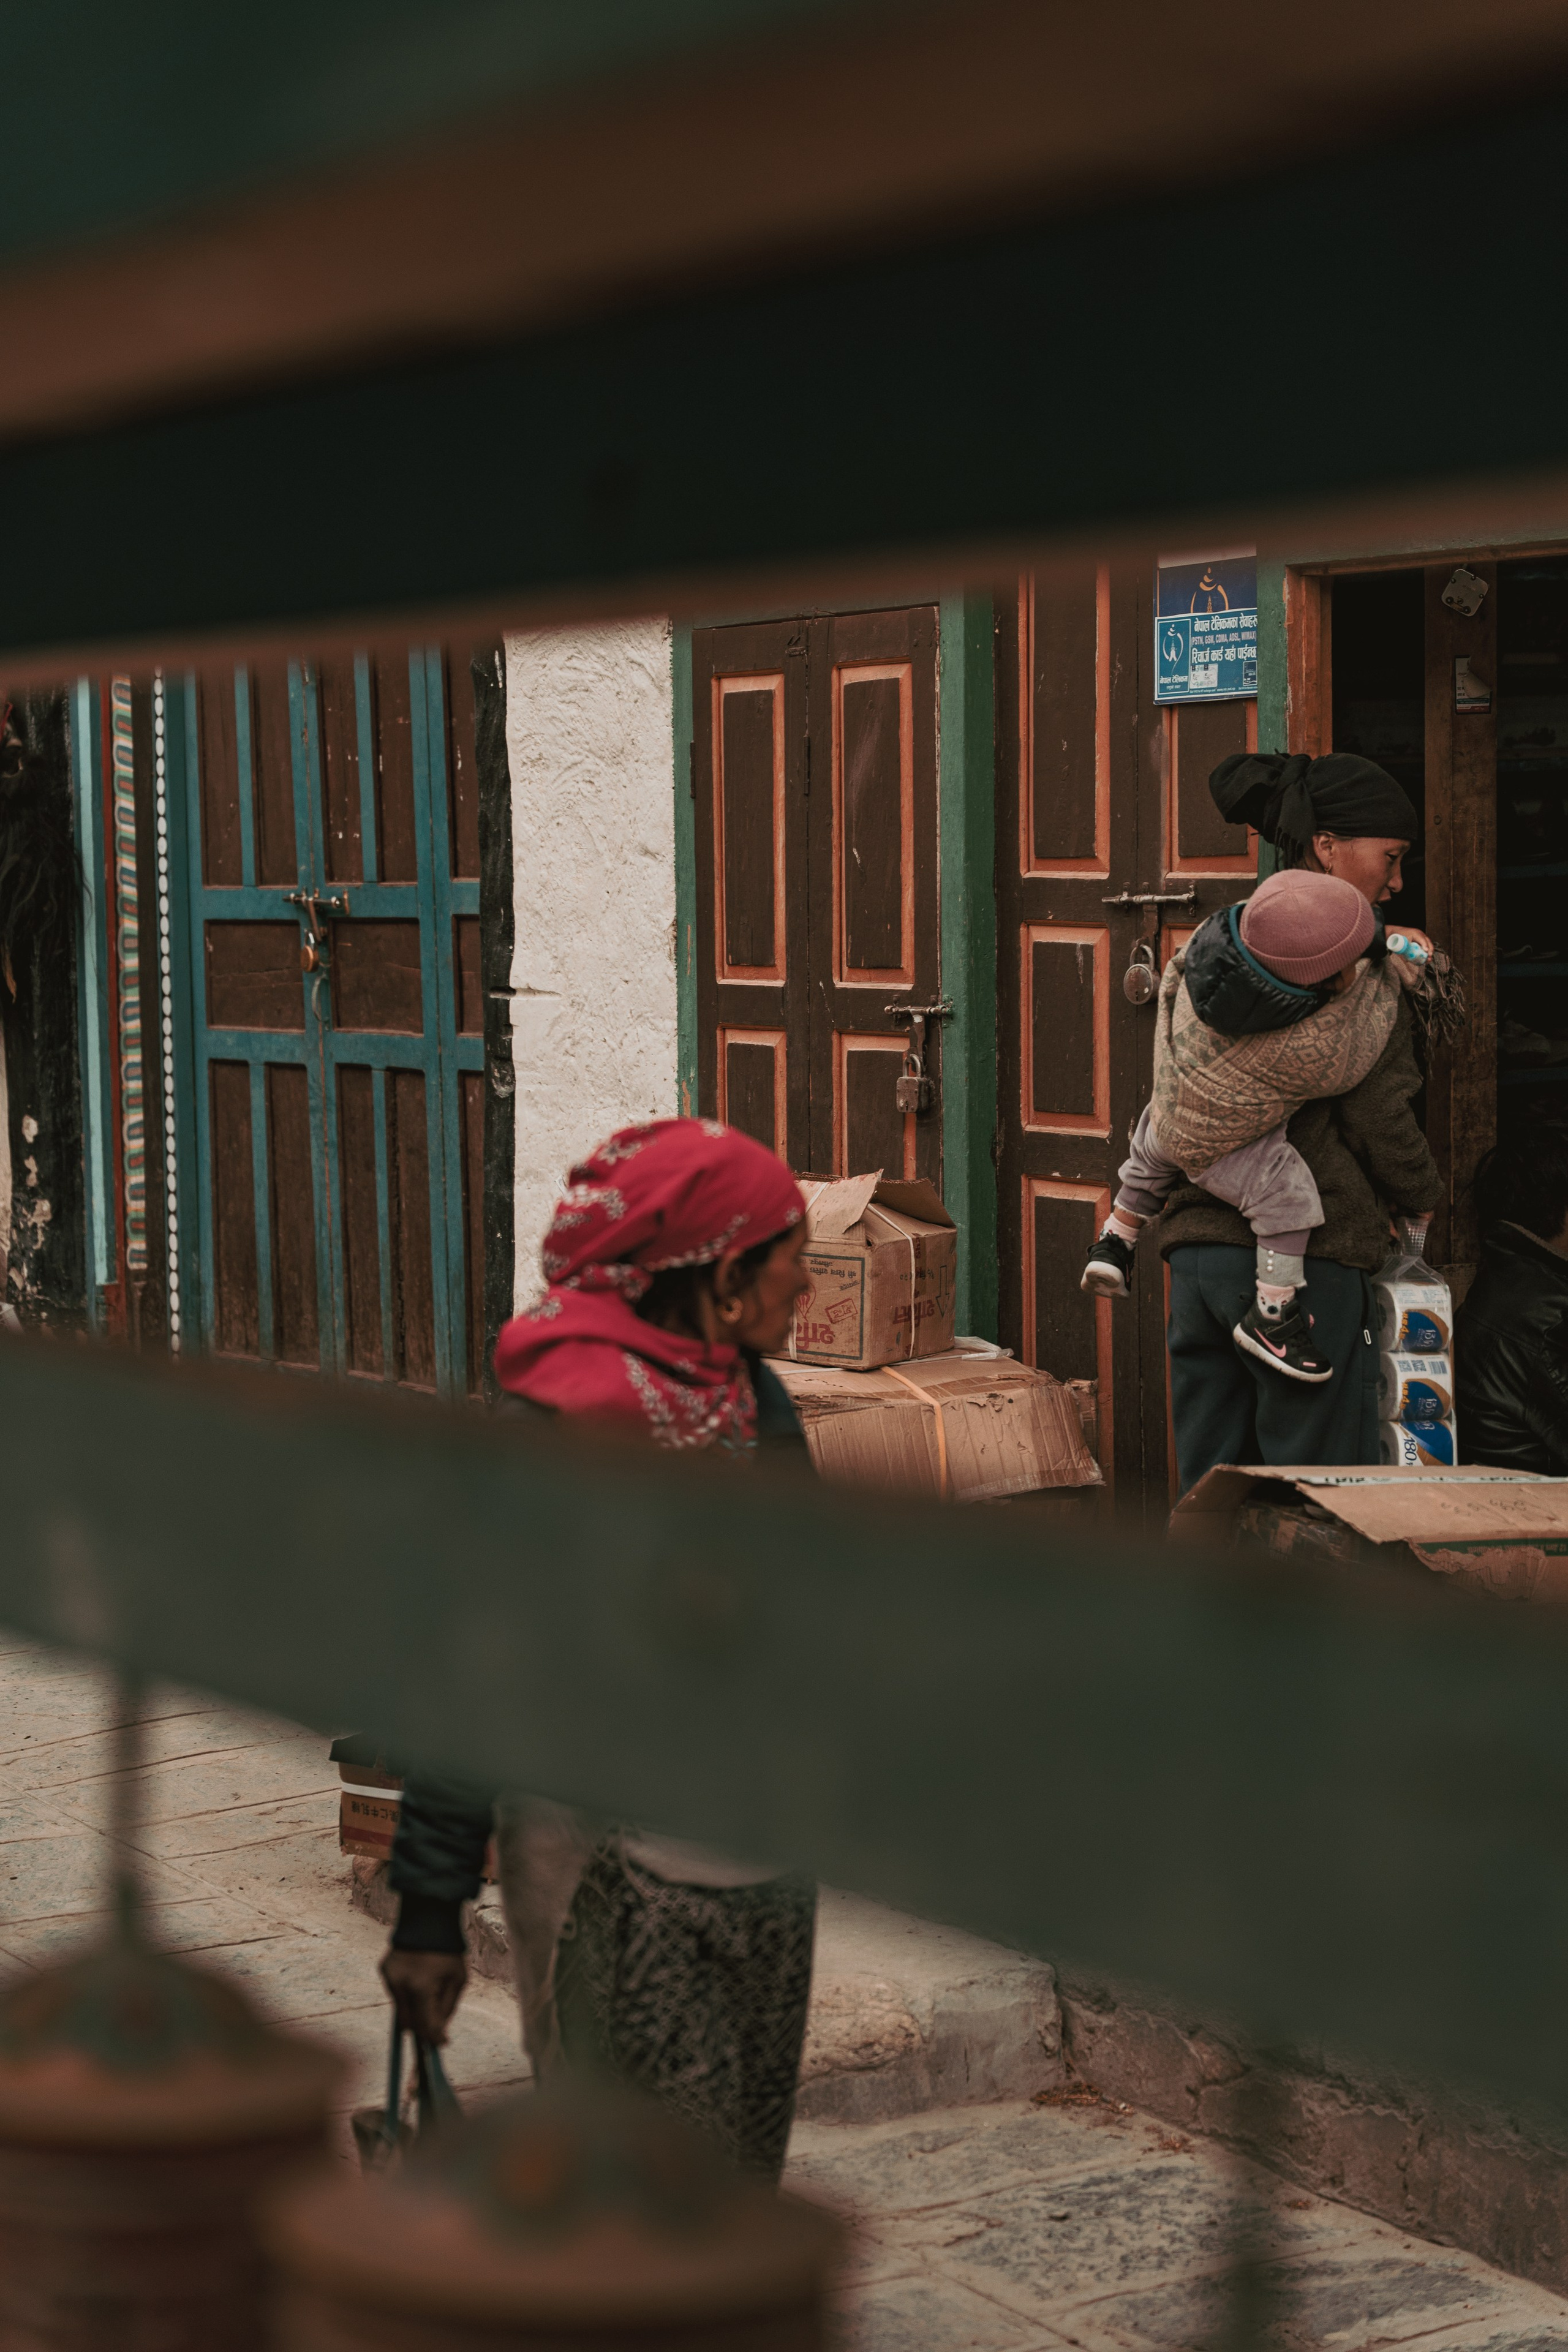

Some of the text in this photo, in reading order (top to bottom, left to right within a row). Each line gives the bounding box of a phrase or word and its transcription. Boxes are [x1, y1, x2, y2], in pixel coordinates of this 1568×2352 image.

[1194, 617, 1210, 632] नेपाल
[1211, 615, 1238, 631] टेलिकमका
[1205, 635, 1215, 645] GSM,
[1215, 633, 1229, 644] CDMA,
[1229, 632, 1241, 643] ADSL,
[1191, 647, 1210, 664] रिचार्ज
[1210, 646, 1224, 662] कार्ड
[1224, 644, 1236, 662] यहाँ
[1159, 676, 1172, 684] नेपाल
[809, 1267, 828, 1276] शक्ति
[830, 1269, 845, 1278] शिव
[847, 1270, 857, 1279] श्री
[1403, 1436, 1417, 1461] 180
